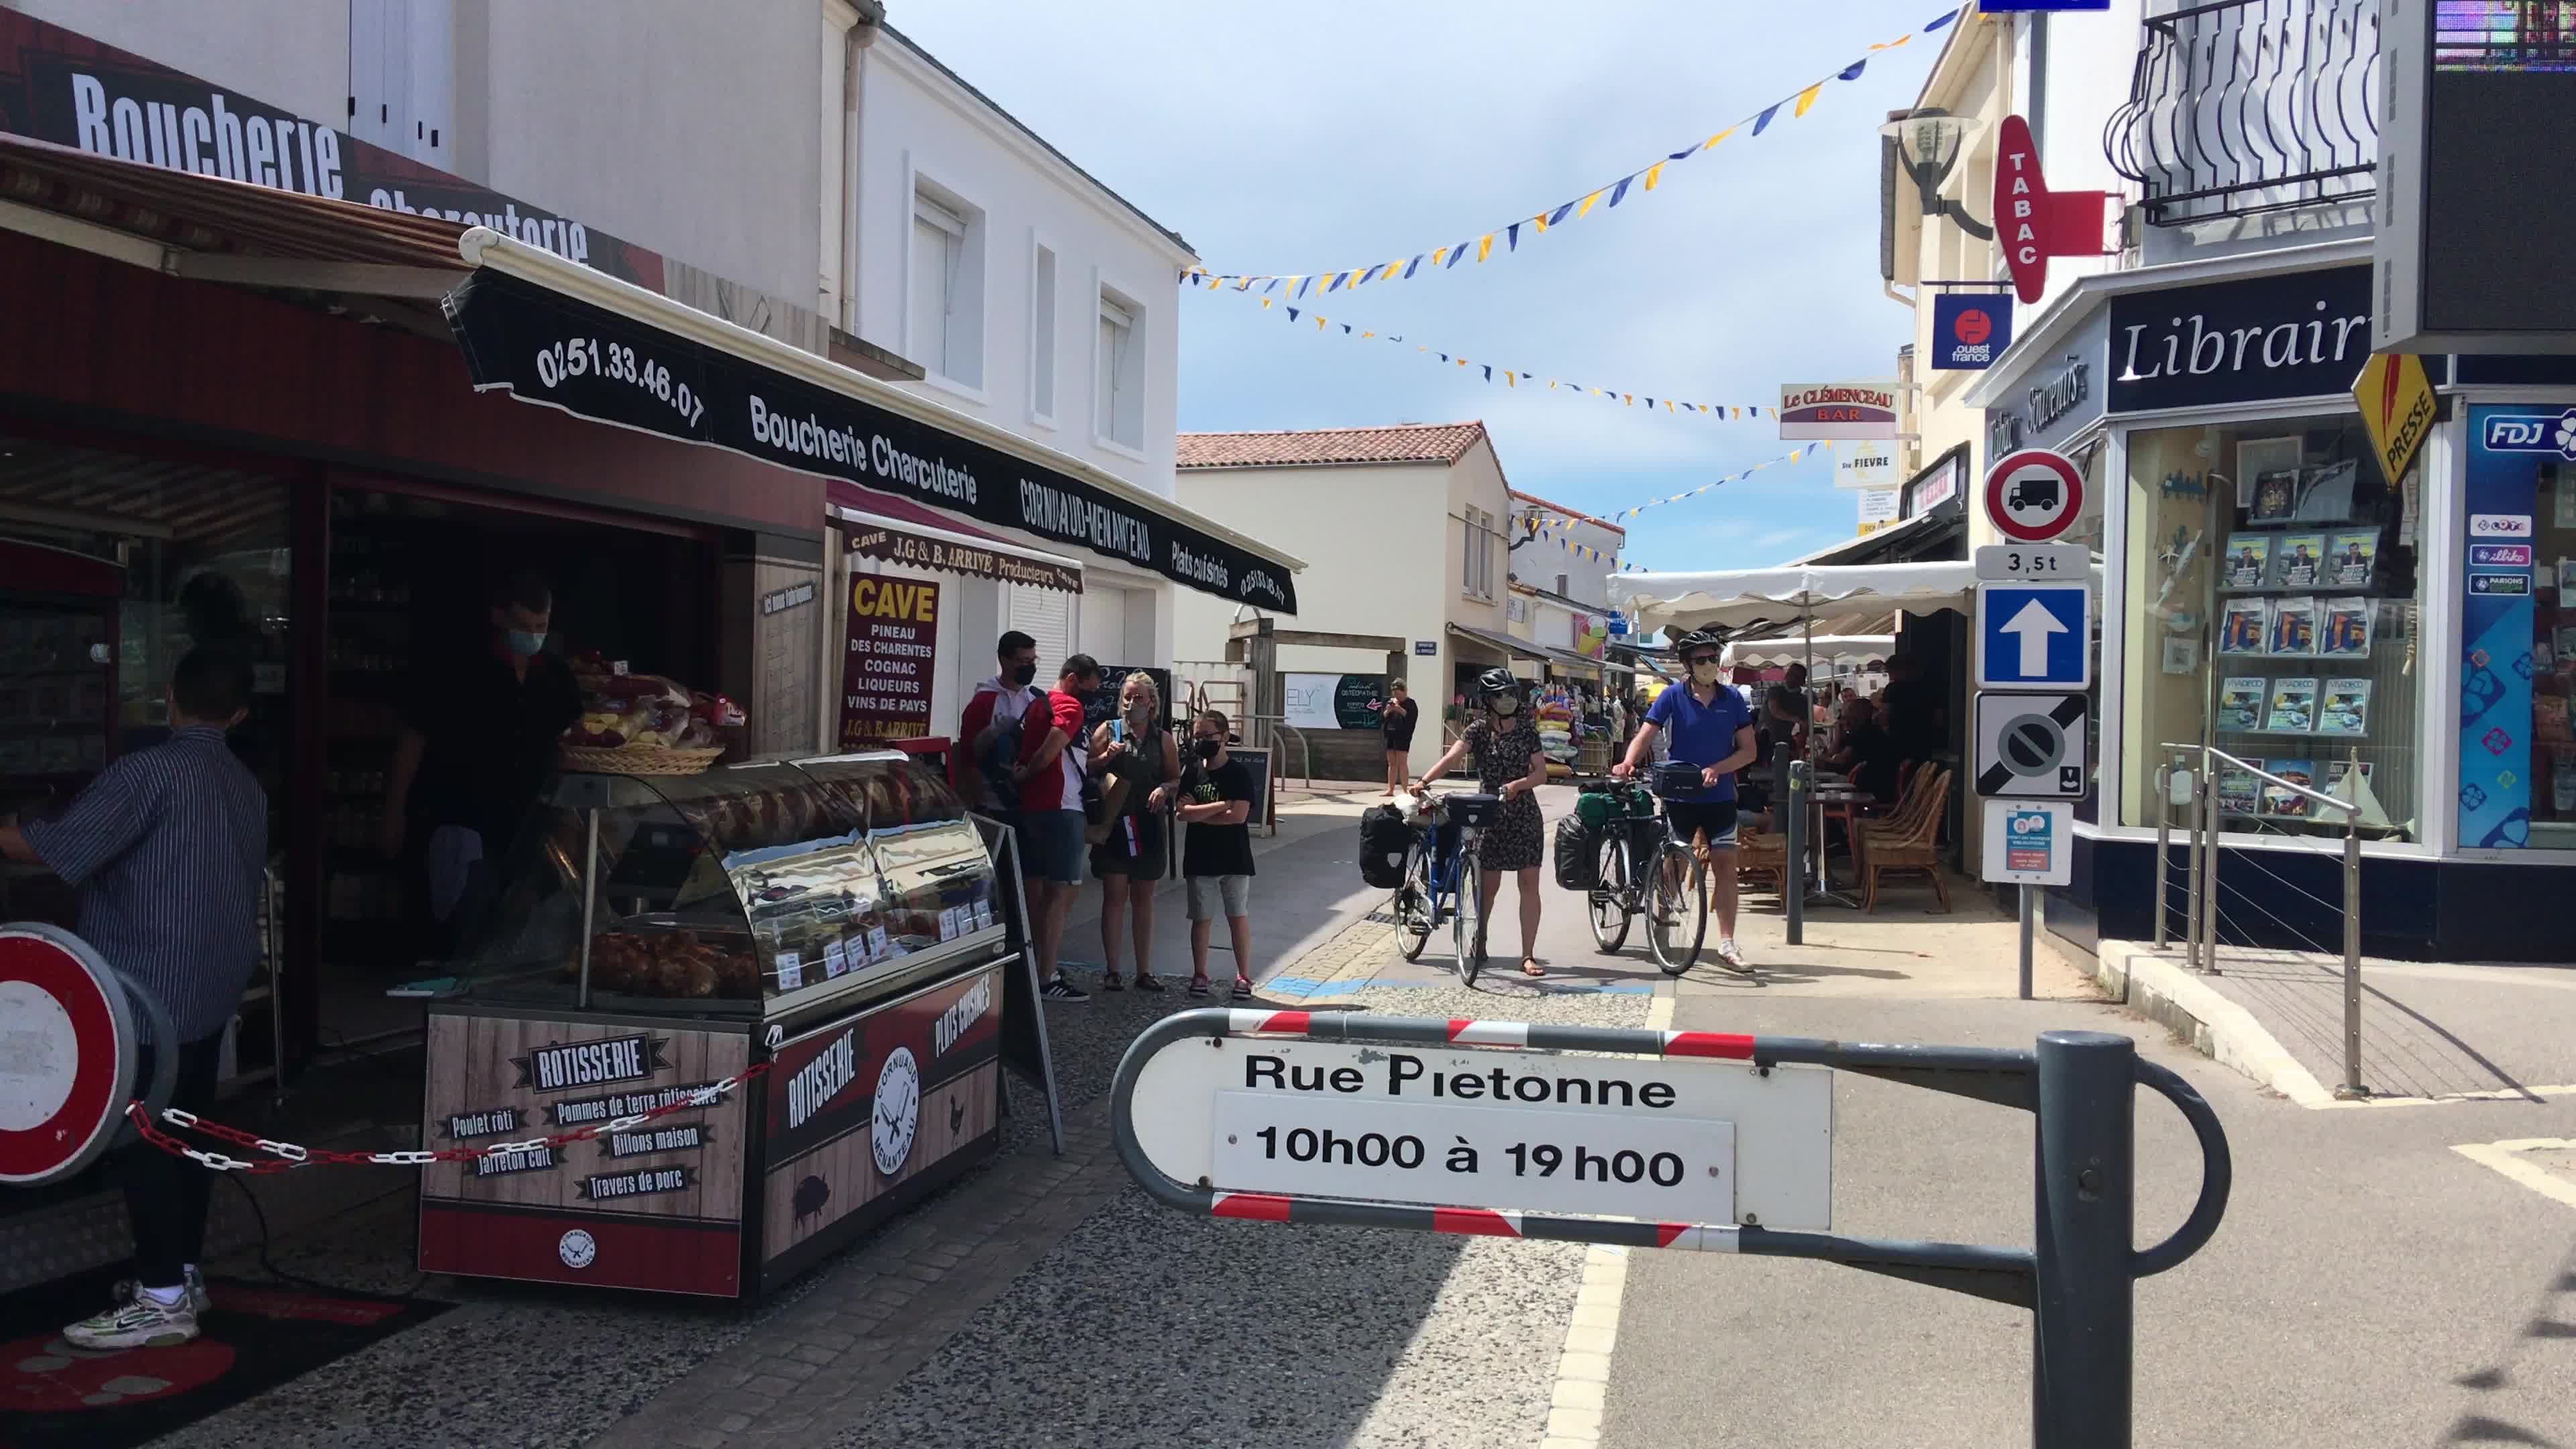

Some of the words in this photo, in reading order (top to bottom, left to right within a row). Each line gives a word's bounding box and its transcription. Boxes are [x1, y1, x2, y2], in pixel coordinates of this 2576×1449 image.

[72, 72, 343, 199] Boucherie
[2010, 153, 2037, 264] TABAC
[1952, 350, 1990, 362] france
[1957, 343, 1990, 354] ouest
[2117, 300, 2373, 382] Librair
[537, 338, 704, 428] 0251.33.46.07
[1817, 408, 1862, 420] BAR
[2387, 394, 2432, 471] PRESSE
[2491, 422, 2544, 445] FDJ
[750, 394, 867, 471] Boucherie
[872, 434, 977, 504] Charcuterie
[1172, 541, 1193, 576] Plats
[852, 531, 886, 549] CAVE
[918, 541, 930, 562] &
[999, 559, 1054, 585] Producteurs
[854, 579, 934, 623] CAVE
[871, 625, 915, 640] PINEAU
[851, 639, 871, 653] DES
[873, 641, 932, 658] CHARENTES
[865, 659, 916, 676] COGNAC
[858, 678, 920, 694] LIQUEURS
[848, 696, 876, 710] VINS
[879, 697, 896, 711] DE
[898, 698, 927, 713] PAYS
[936, 1004, 957, 1057] PLATS
[877, 1054, 916, 1099] CORNUAUD
[1246, 1054, 1364, 1093] Rue
[452, 1113, 490, 1138] Poulet
[492, 1110, 513, 1132] rôti
[557, 1099, 606, 1124] Pommes
[609, 1096, 623, 1116] de
[626, 1094, 655, 1114] terre
[612, 1133, 653, 1156] Rillons
[655, 1127, 698, 1150] maison
[874, 1117, 915, 1169] MENANTEAU
[1256, 1126, 1424, 1170] 10h00
[1447, 1136, 1479, 1174] à
[1505, 1142, 1685, 1187] 19h00
[477, 1152, 525, 1175] Jarreton
[528, 1146, 551, 1167] cuit
[590, 1175, 635, 1199] Travers
[638, 1171, 653, 1192] de
[655, 1169, 682, 1191] porc
